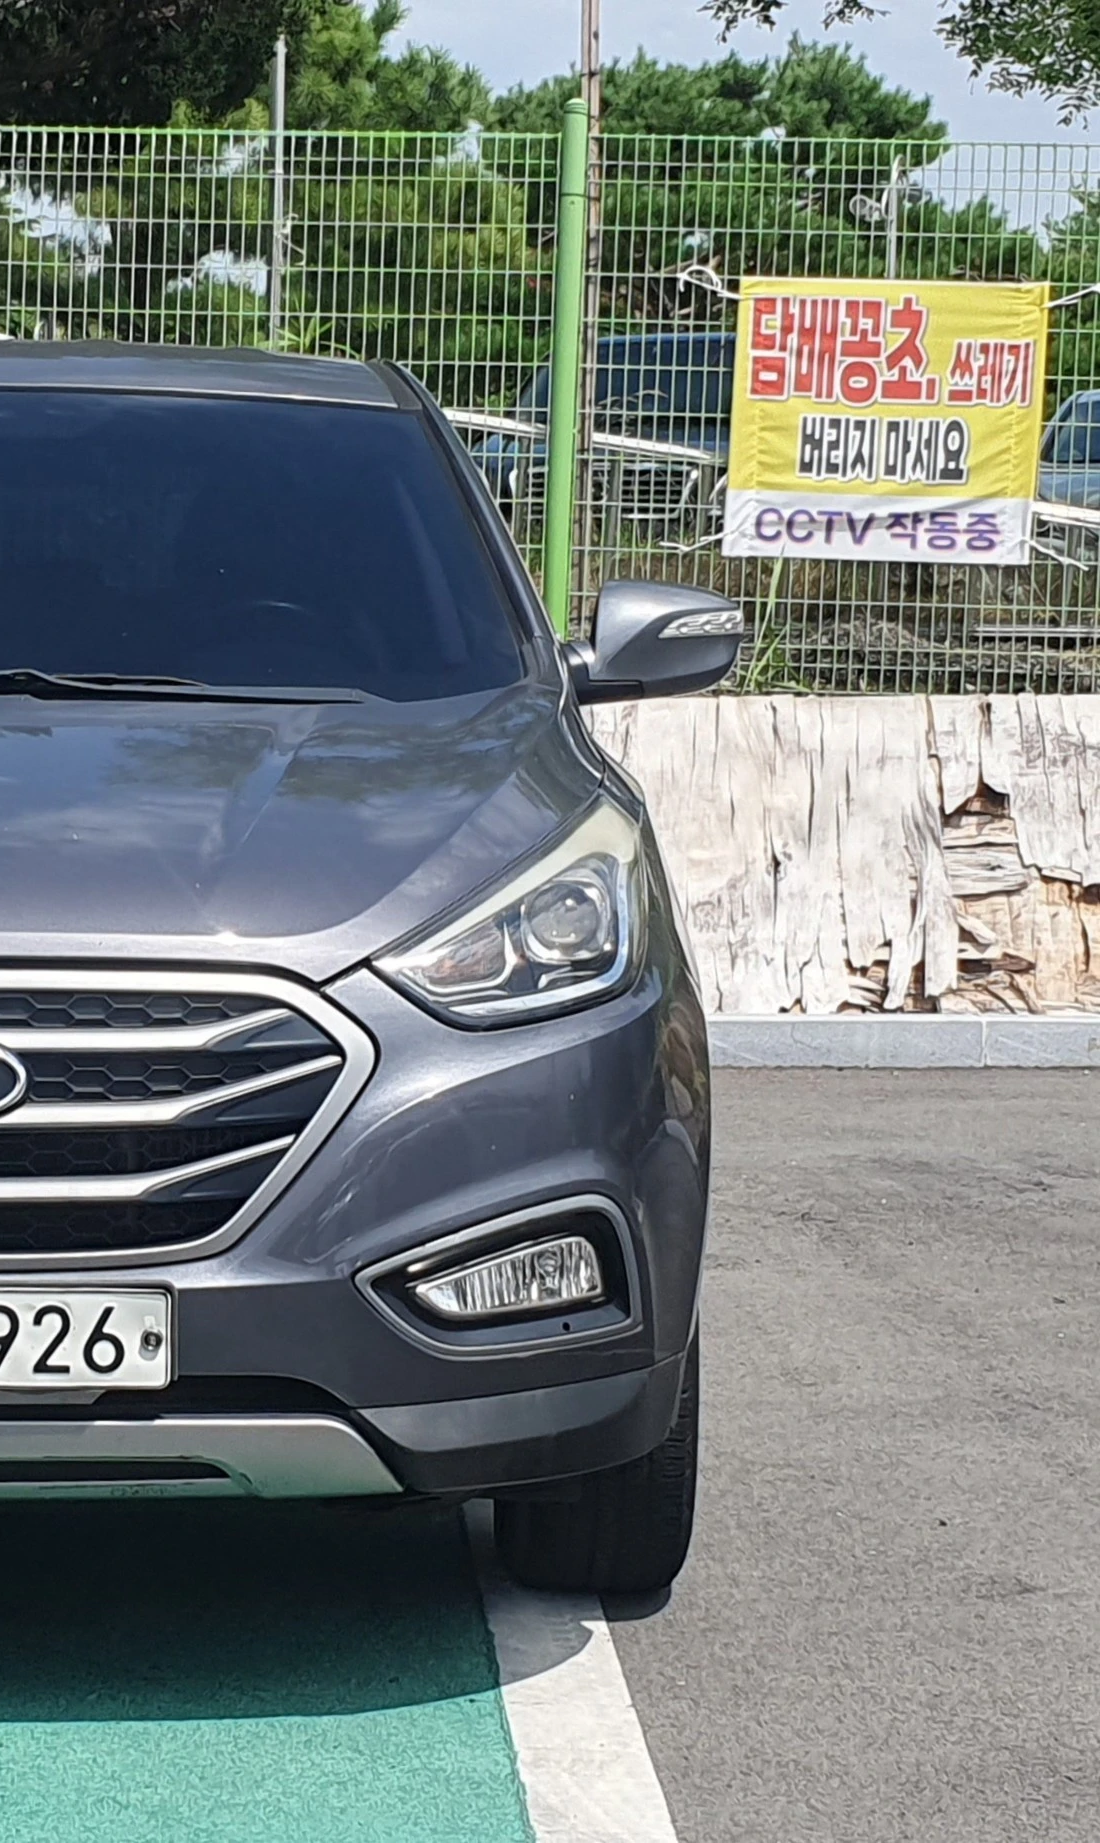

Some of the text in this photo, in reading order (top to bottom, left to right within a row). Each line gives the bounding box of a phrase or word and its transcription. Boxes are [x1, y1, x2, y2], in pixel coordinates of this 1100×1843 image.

[947, 340, 1034, 404] 쓰레기
[799, 416, 967, 483] 버리지 마세요
[755, 507, 1001, 551] CCTV 작동중
